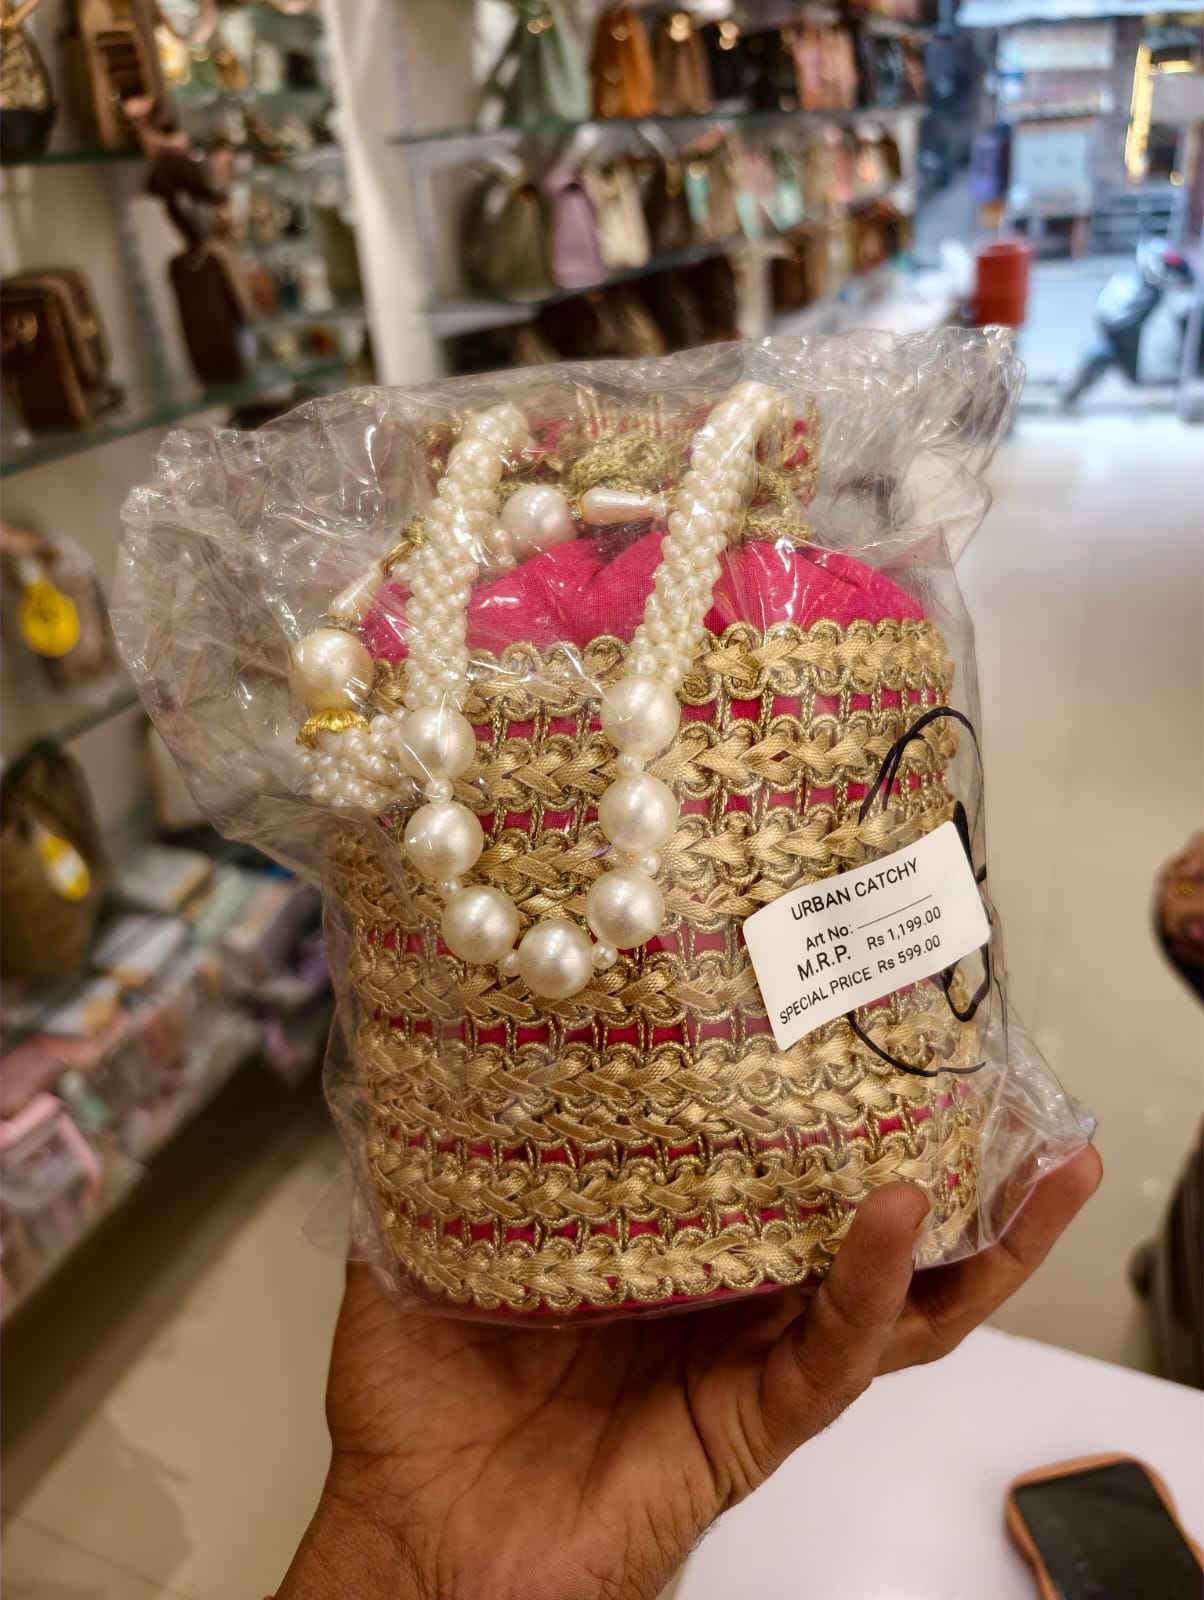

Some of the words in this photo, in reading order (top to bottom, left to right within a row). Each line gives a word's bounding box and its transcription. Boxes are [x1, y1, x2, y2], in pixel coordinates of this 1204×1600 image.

[791, 887, 851, 921] URBAN
[854, 857, 919, 897] CATCHY
[797, 944, 851, 981] M.R.P.
[867, 934, 885, 950] Rs
[888, 906, 942, 942] 1,199.00
[806, 933, 826, 951] Art
[828, 924, 854, 943] No:
[780, 986, 828, 1025] SPECIAL
[829, 967, 873, 995] PRICE
[877, 957, 895, 974] Rs
[897, 934, 941, 965] 599.00
